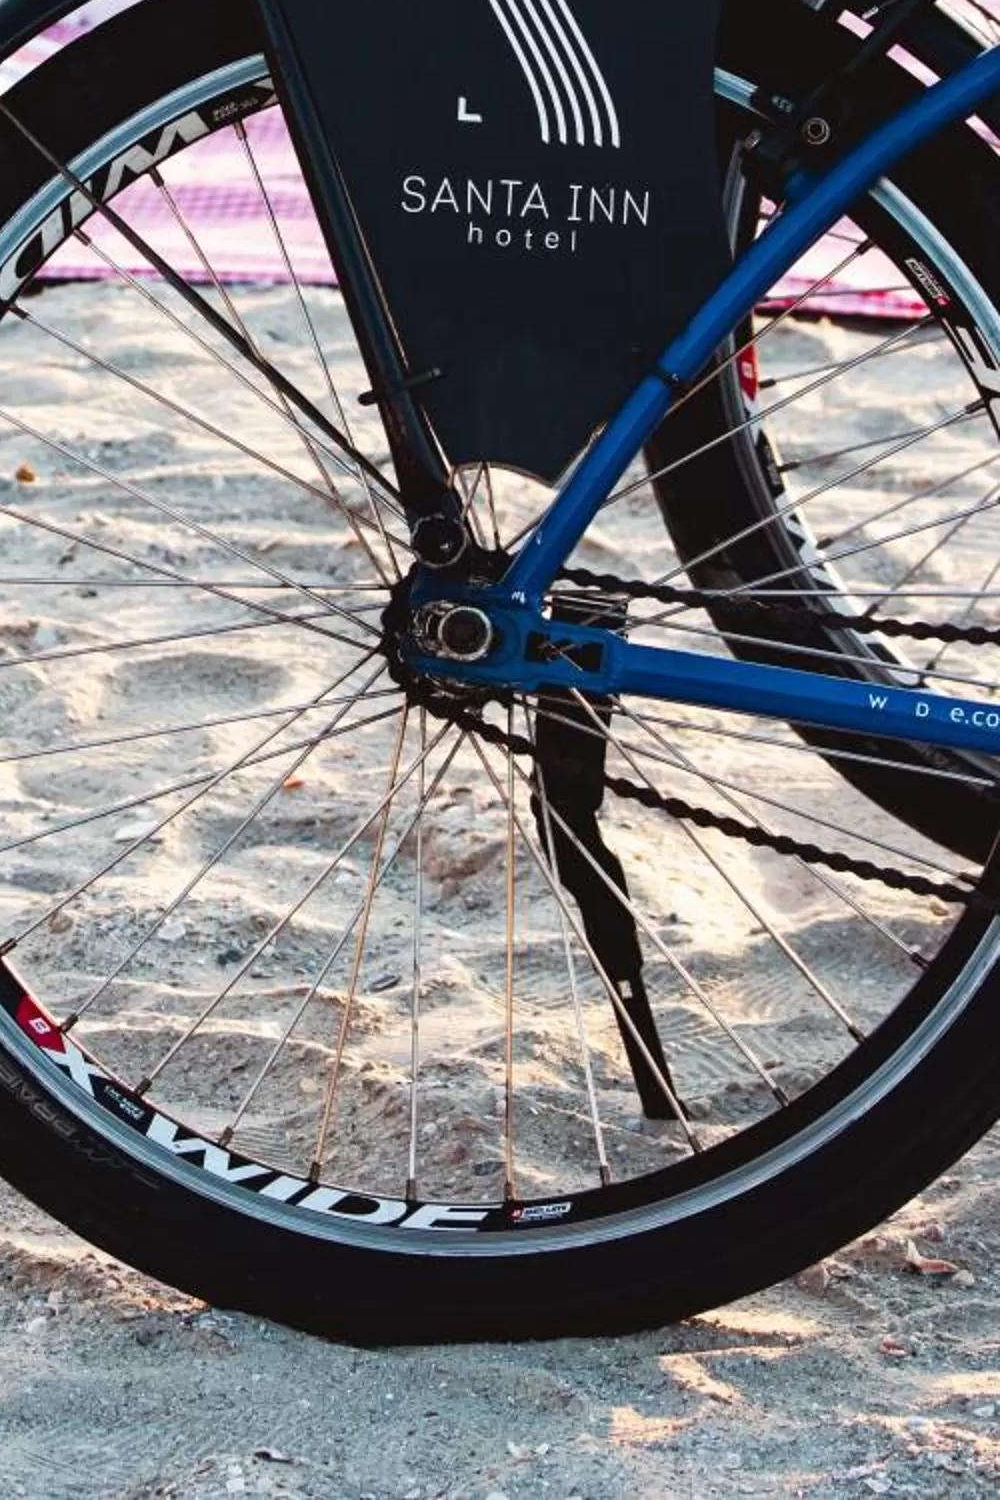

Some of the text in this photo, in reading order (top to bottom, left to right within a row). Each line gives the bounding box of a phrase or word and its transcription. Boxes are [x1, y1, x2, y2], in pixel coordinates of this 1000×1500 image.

[401, 175, 649, 227] SANTA INN
[467, 222, 577, 251] hotel
[145, 1113, 500, 1233] WIDE
